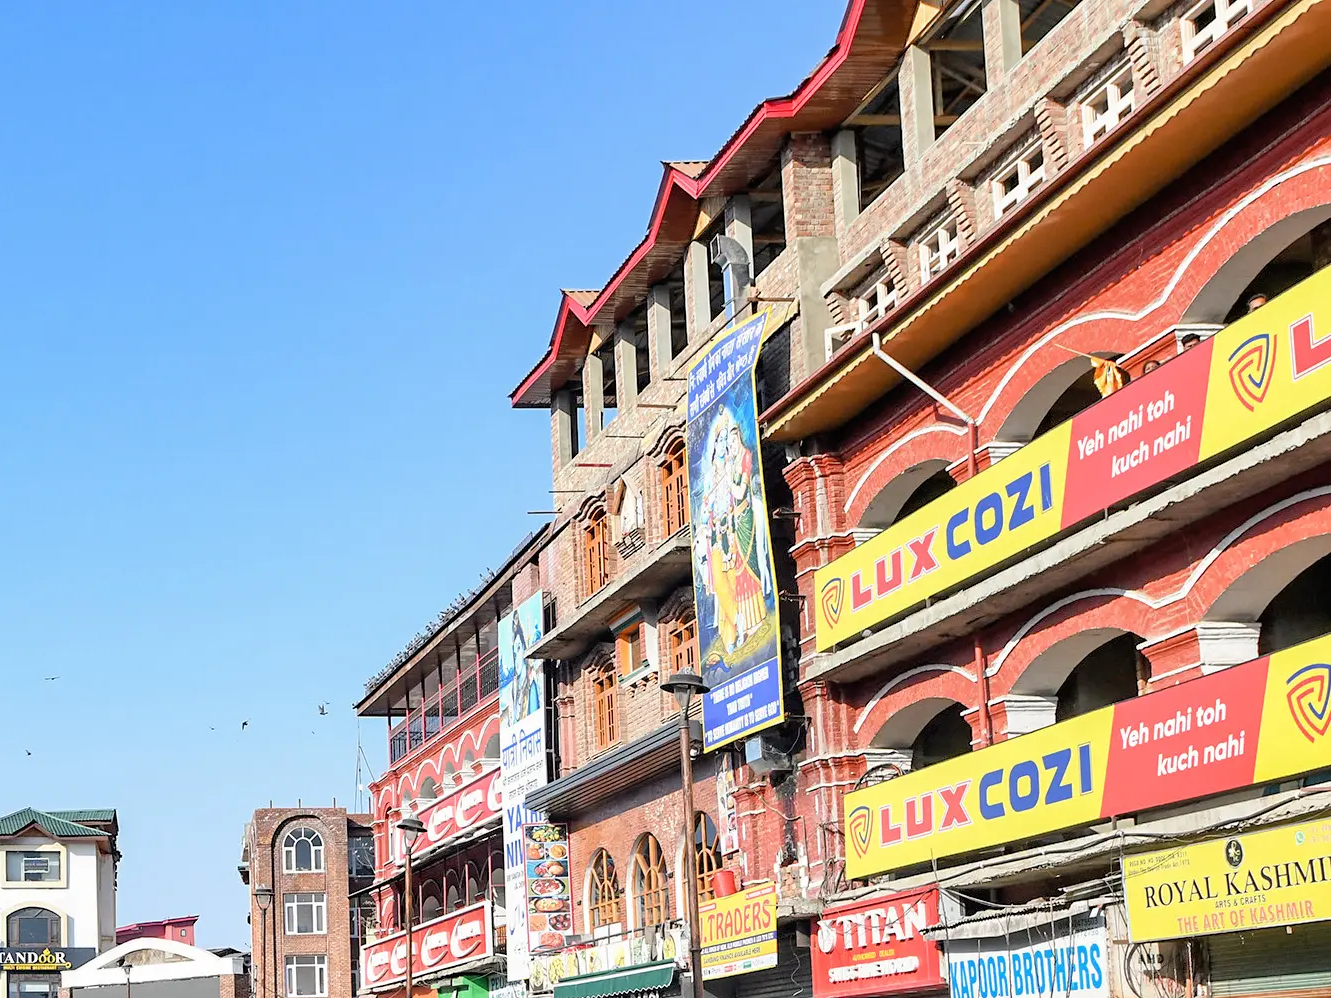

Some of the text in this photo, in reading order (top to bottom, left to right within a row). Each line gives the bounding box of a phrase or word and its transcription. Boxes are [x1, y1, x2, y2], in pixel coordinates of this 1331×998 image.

[1077, 390, 1175, 462] Yeh nahi toh
[1111, 417, 1191, 478] kuch nahi
[850, 462, 1052, 612] LUX COZI
[1120, 698, 1226, 750] Yeh nahi toh
[1157, 731, 1245, 777] kuch nahi
[878, 742, 1094, 847] LUX COZI
[1144, 855, 1331, 908] ROYAL KASHMI
[1215, 894, 1266, 909] ARTS & CRAFTS
[836, 901, 927, 949] TITAN
[1177, 900, 1315, 933] THE ART OF KASHMIR
[1012, 943, 1103, 996] BROTHERS
